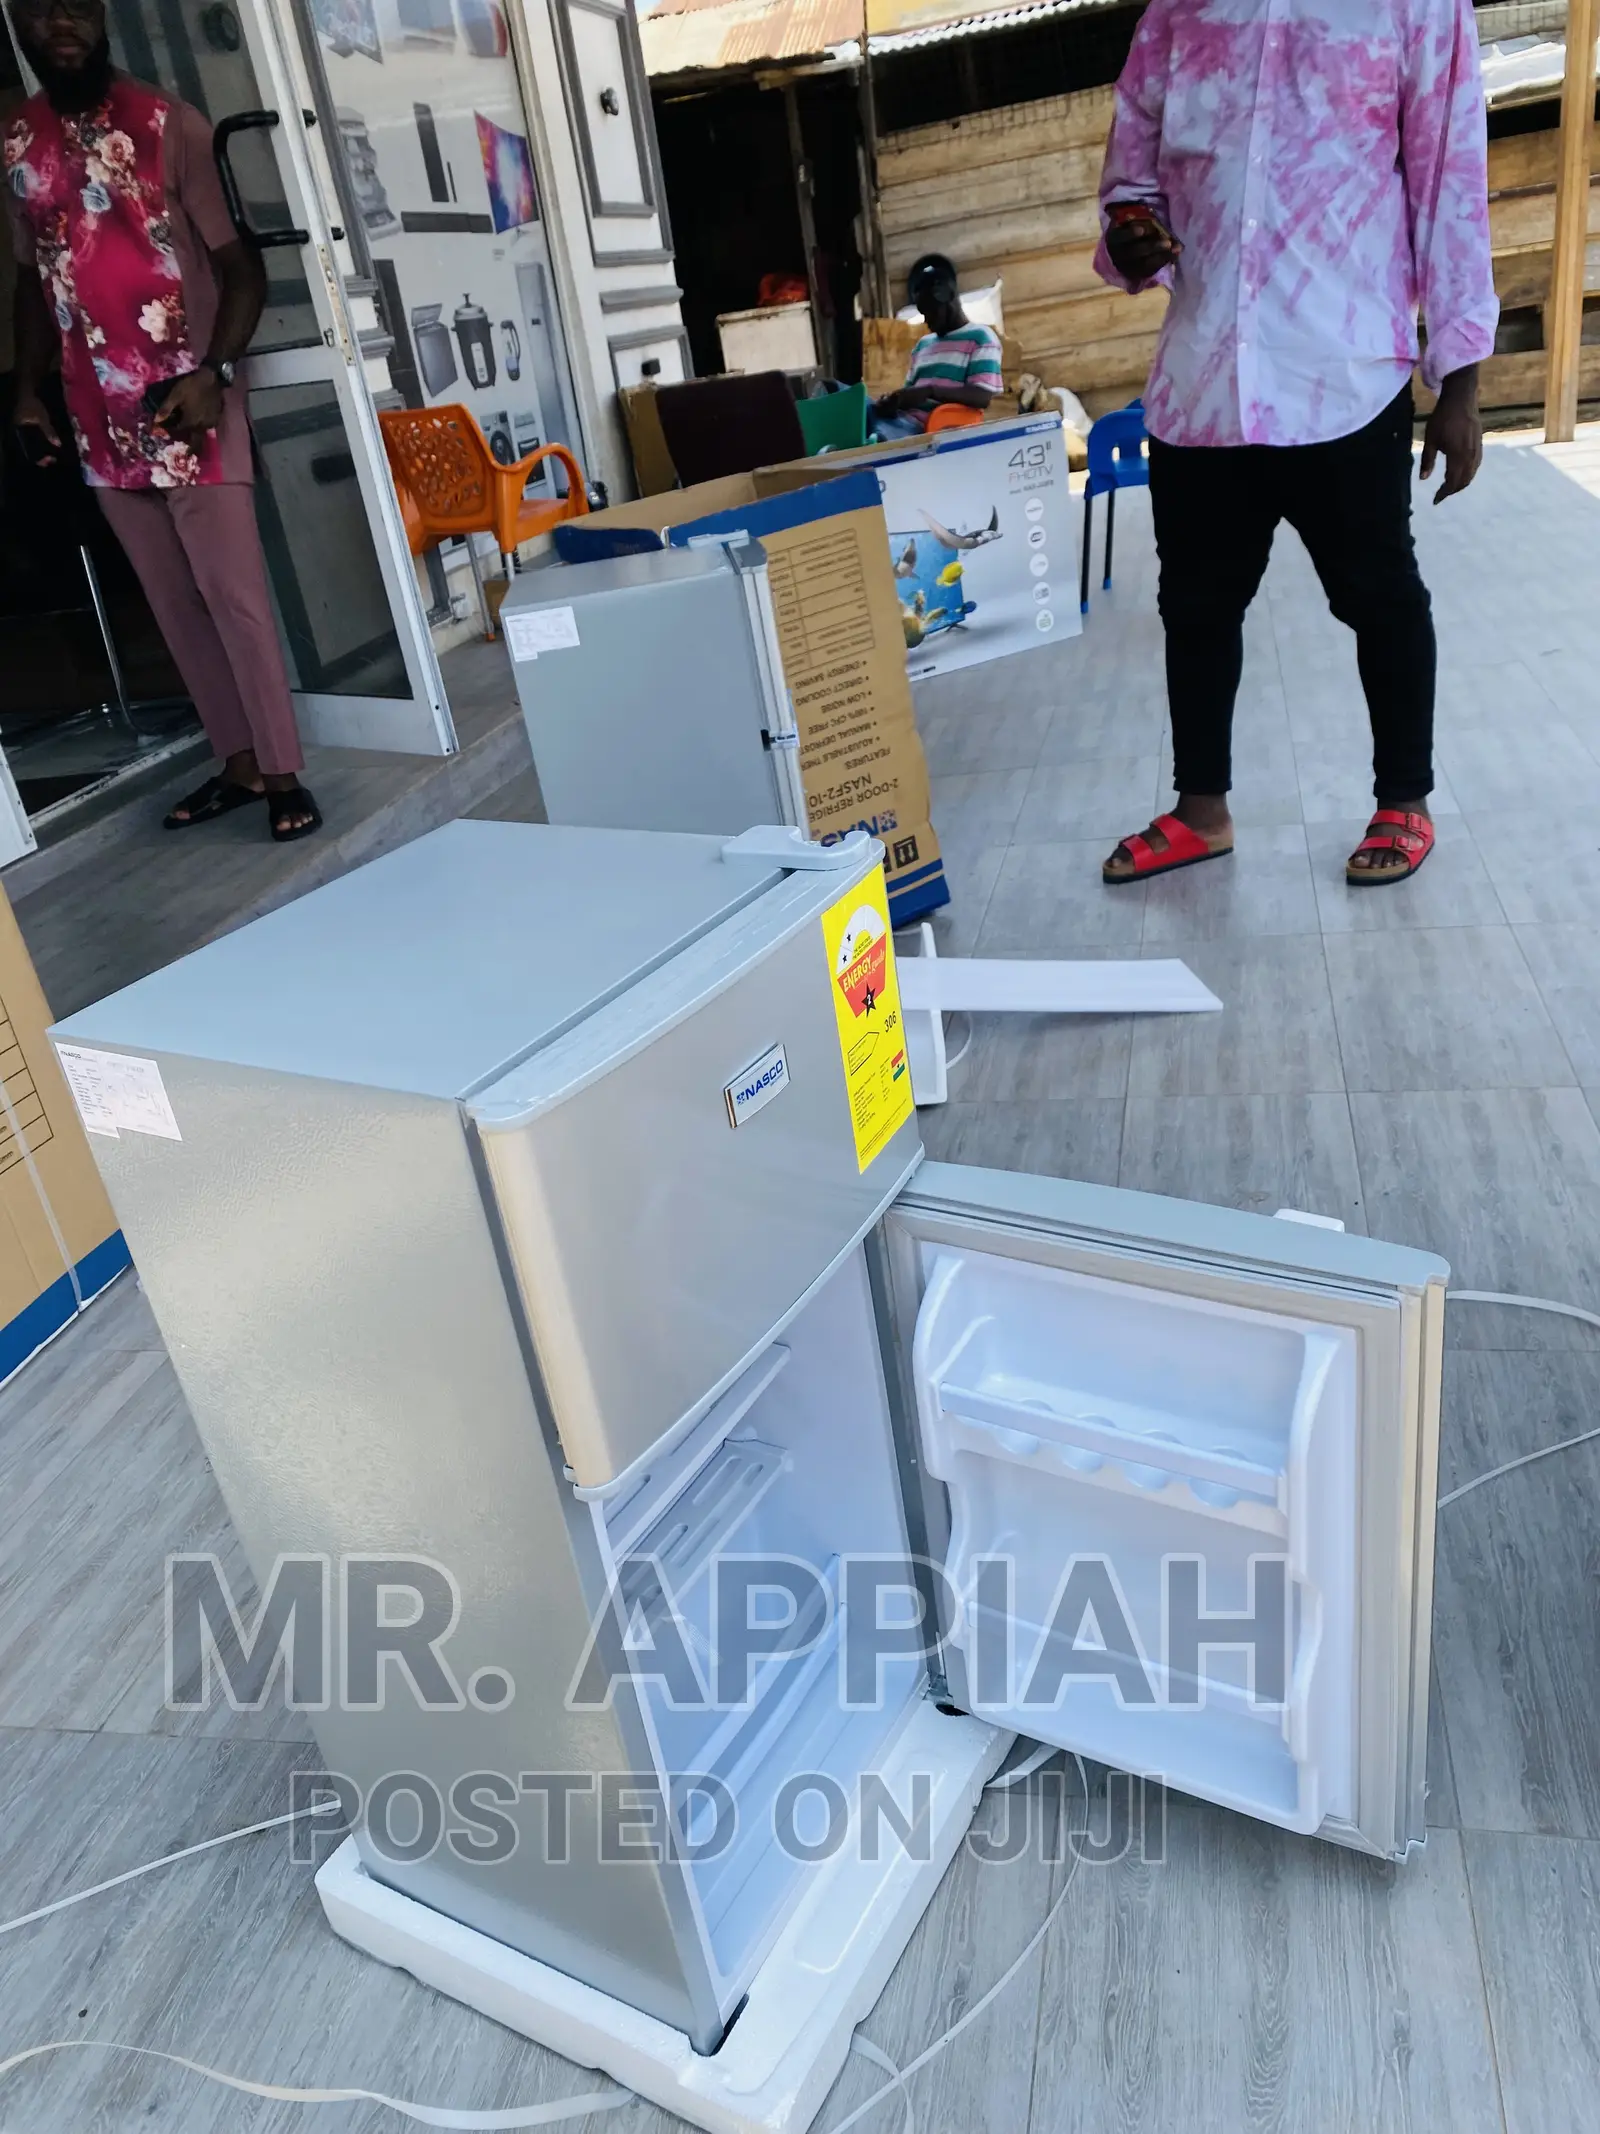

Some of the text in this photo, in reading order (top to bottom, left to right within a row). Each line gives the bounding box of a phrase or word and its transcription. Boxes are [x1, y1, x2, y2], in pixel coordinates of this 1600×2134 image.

[1008, 440, 1052, 468] 43"
[795, 660, 860, 690] ENERGY SAVING
[795, 676, 863, 706] DIRECT COOLING
[821, 691, 867, 714] LOW NOISE
[808, 722, 829, 736] FREE
[830, 715, 847, 727] CFC
[799, 722, 871, 756] MANUAL DEFROST
[822, 737, 874, 763] ADJUSTABLE
[856, 778, 899, 803] 2-DOOR
[843, 955, 872, 992] ENERGY
[883, 1011, 898, 1033] 306
[745, 1060, 784, 1101] NASCO
